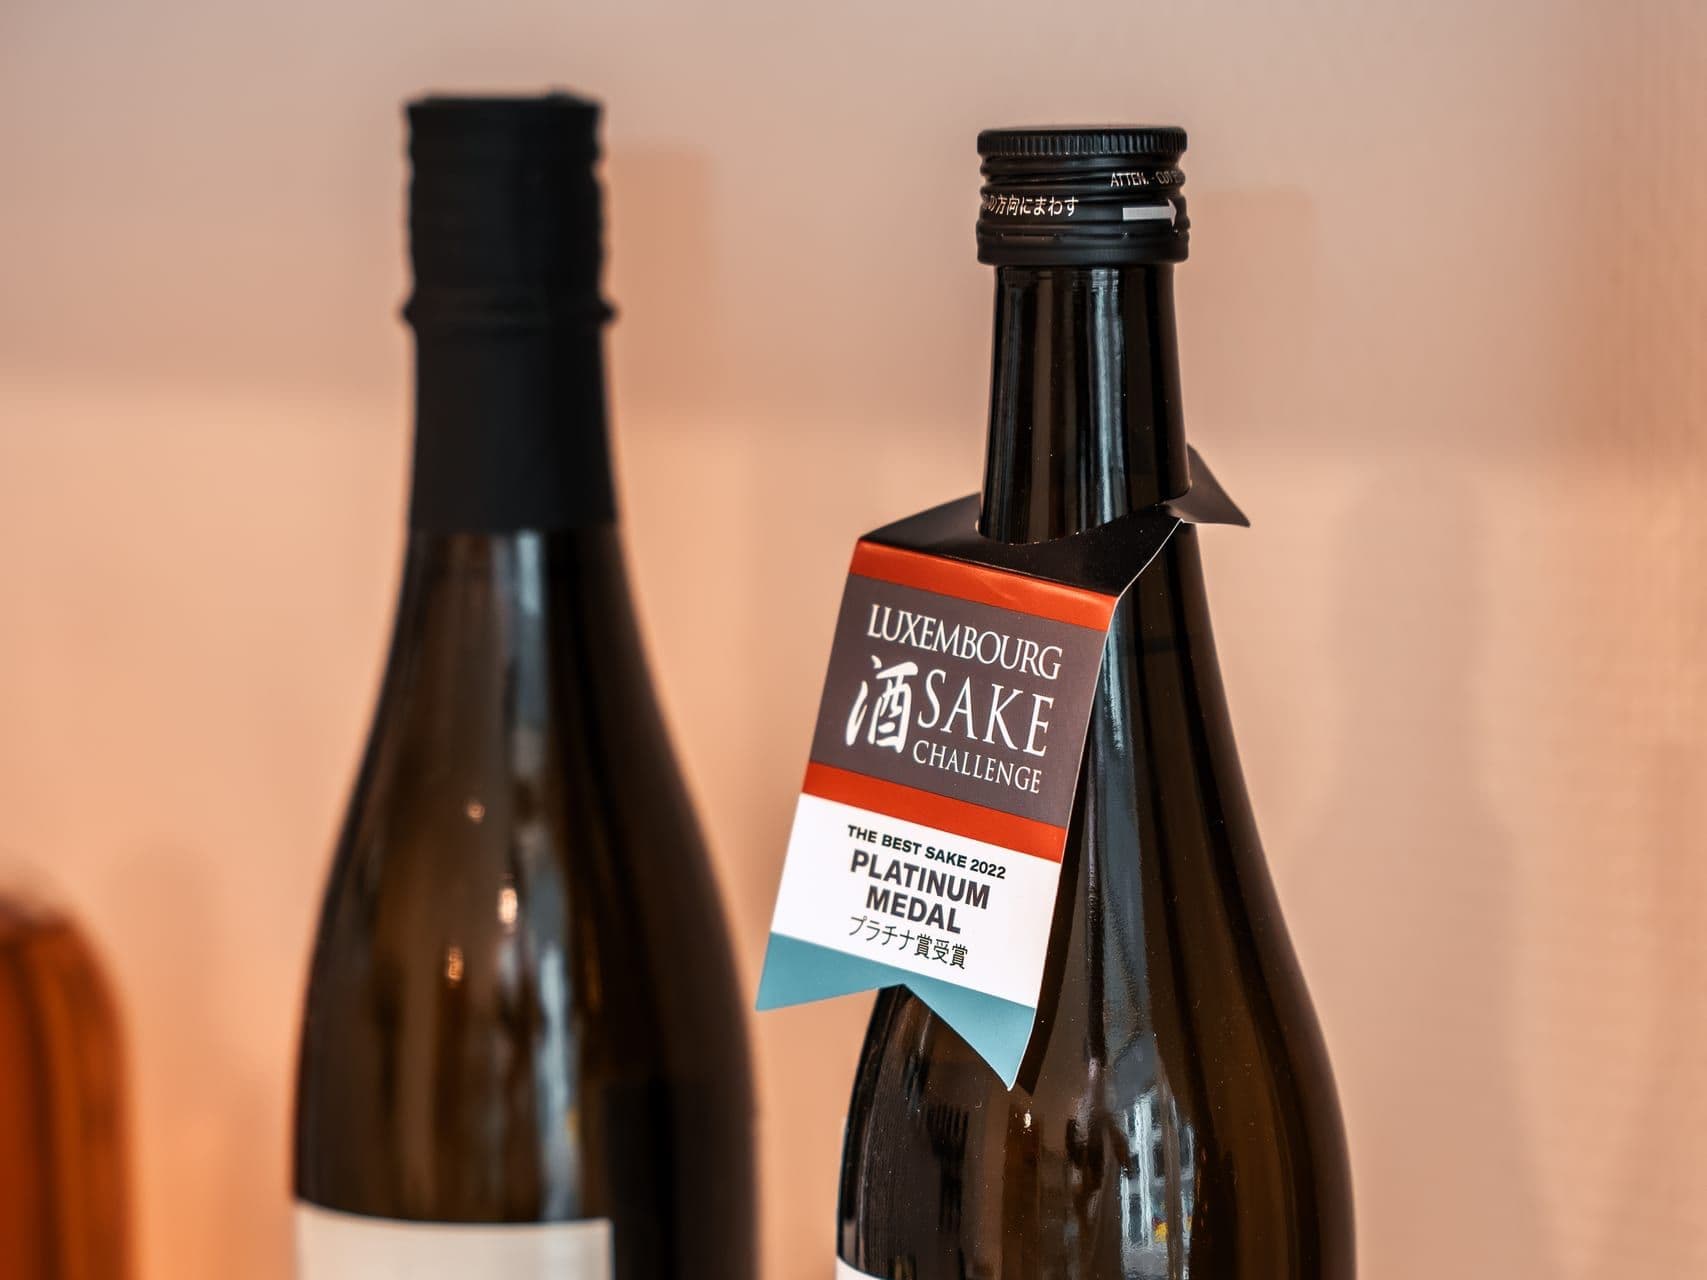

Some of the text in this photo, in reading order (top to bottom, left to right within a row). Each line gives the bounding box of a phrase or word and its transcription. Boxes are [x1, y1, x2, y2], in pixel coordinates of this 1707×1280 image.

[1110, 171, 1149, 187] ATTEN.
[867, 604, 1063, 680] LUXEMBOURG
[846, 654, 919, 753] 酒
[918, 668, 1054, 757] SAKE
[913, 740, 1042, 794] CHALLENGE
[847, 824, 1006, 879] THE BEST SAKE 2022
[850, 849, 990, 910] PLATINUM
[866, 886, 961, 934] MEDAL
[849, 915, 968, 970] プラチナ賞受賞
